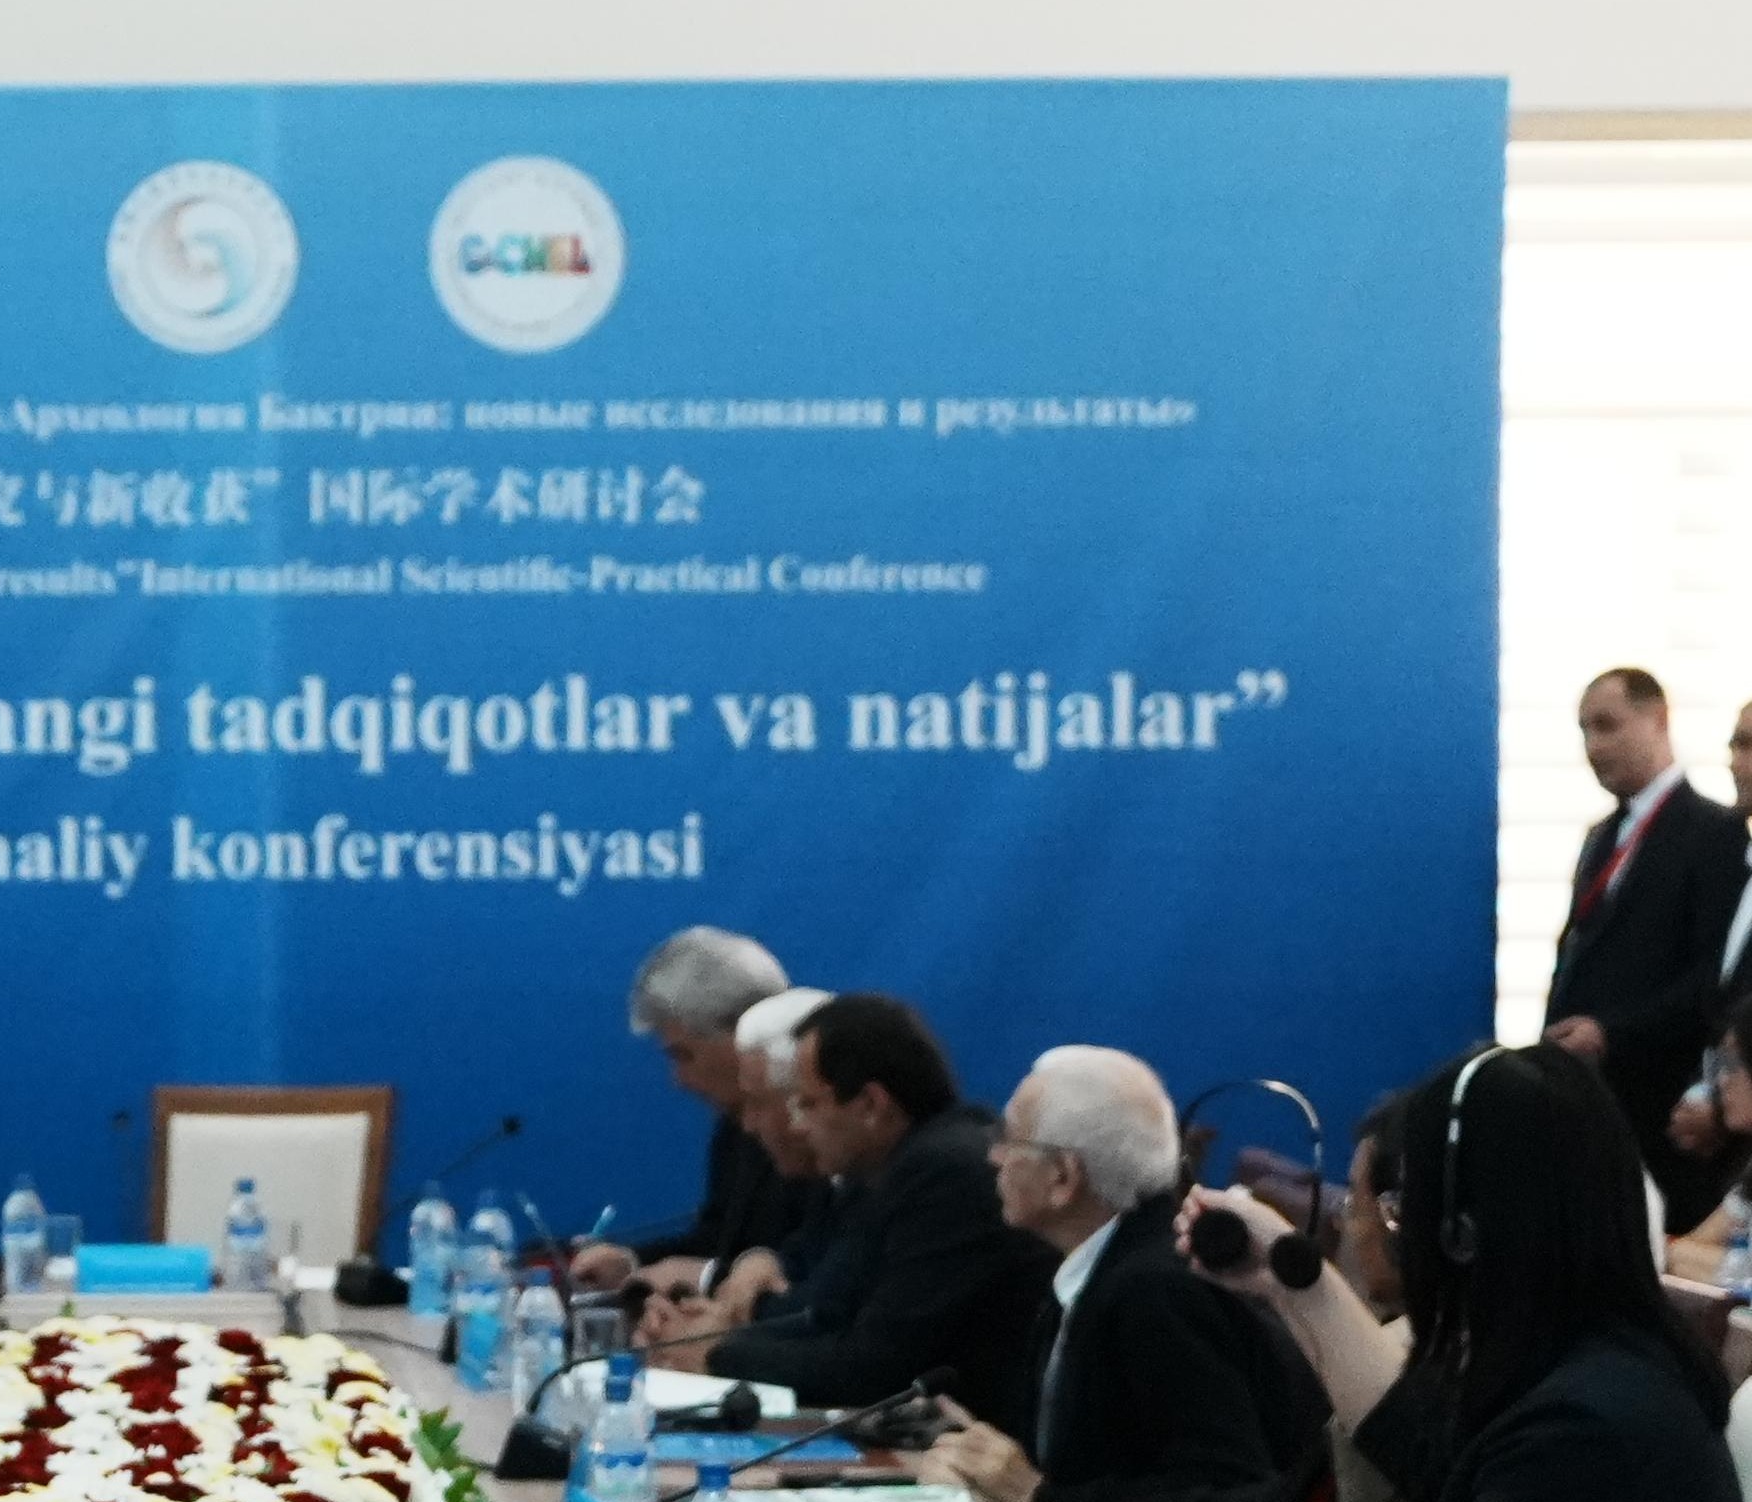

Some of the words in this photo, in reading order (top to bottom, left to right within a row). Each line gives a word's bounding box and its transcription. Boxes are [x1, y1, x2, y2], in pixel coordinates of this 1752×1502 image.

[897, 399, 926, 428] и
[401, 555, 762, 594] Scientific-Practical
[767, 554, 988, 593] Conference
[185, 673, 691, 775] tadqiqotlar
[714, 693, 817, 752] va
[847, 669, 1289, 772] natijalar”
[171, 813, 704, 898] konferensiyasi
